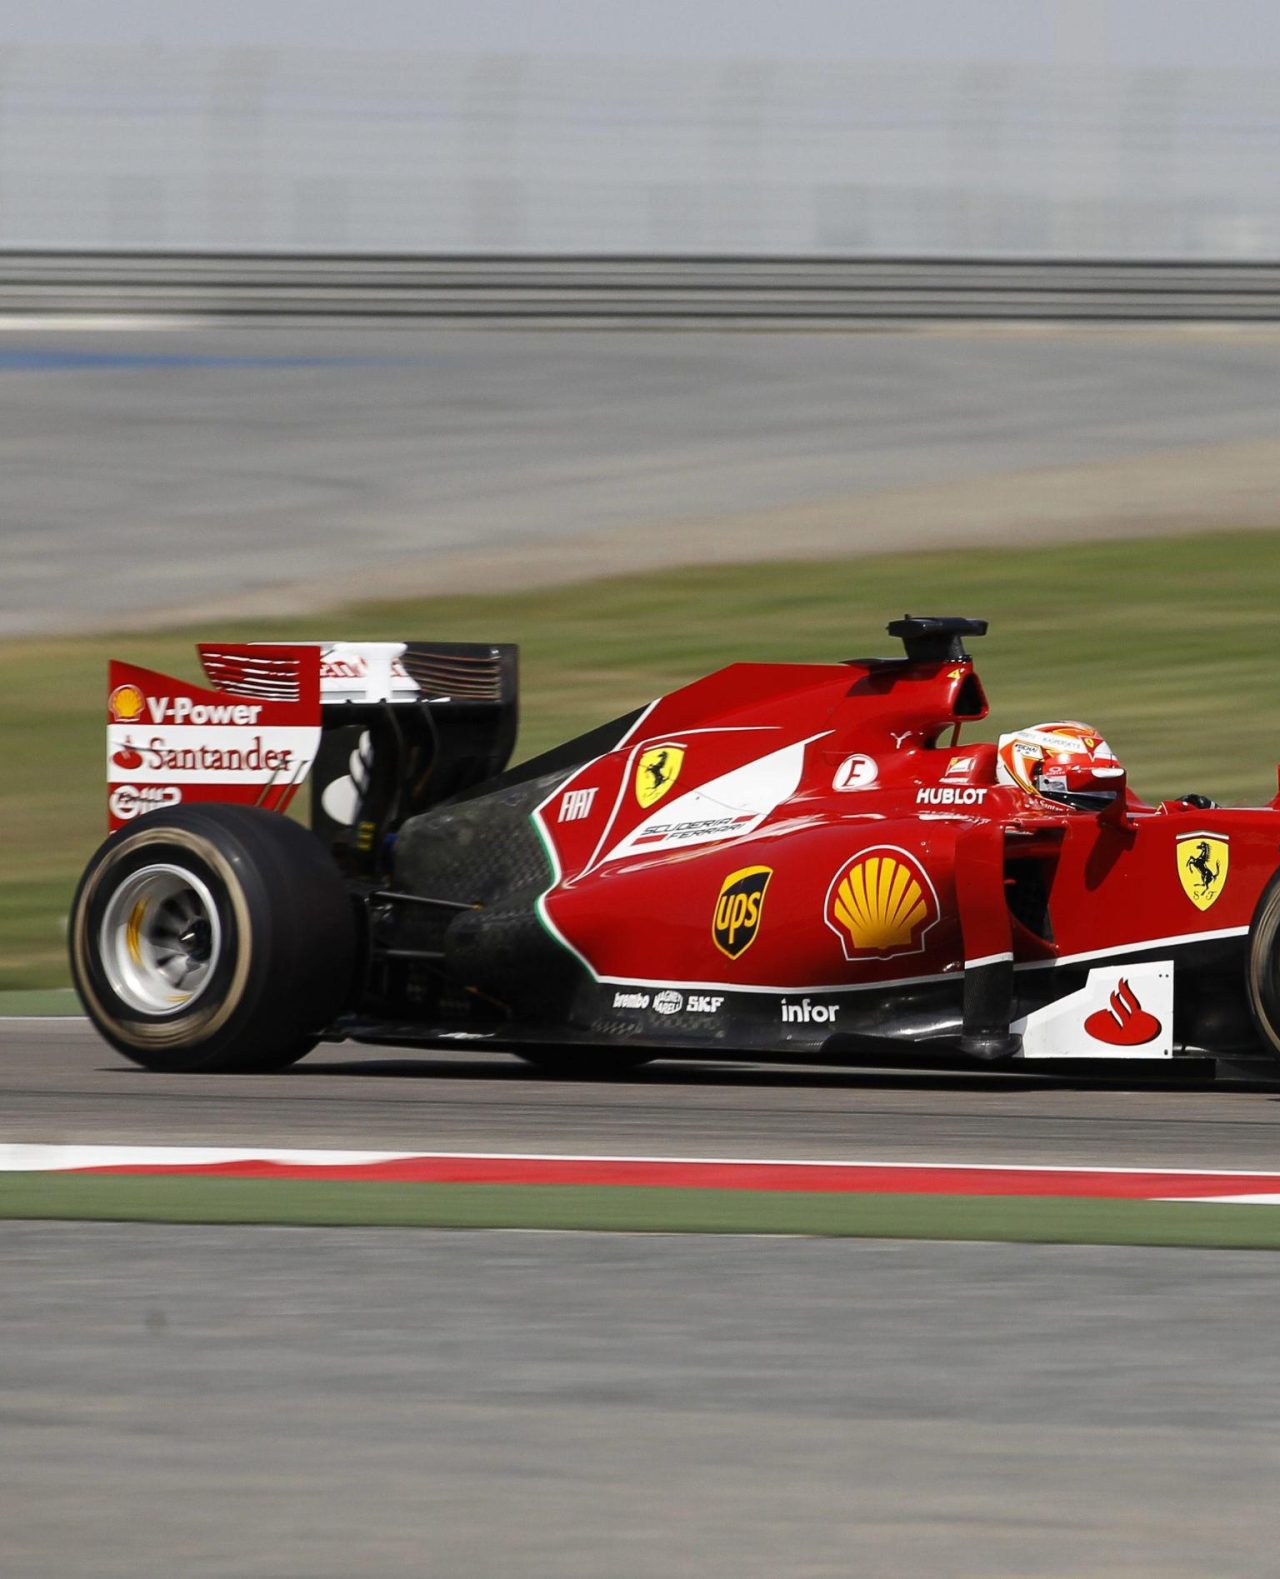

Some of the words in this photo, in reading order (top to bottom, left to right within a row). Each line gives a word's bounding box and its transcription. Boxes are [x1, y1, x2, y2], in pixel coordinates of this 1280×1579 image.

[146, 697, 262, 724] V-Power
[149, 736, 292, 771] Santander
[557, 788, 599, 823] FIAT
[915, 788, 988, 805] HUBLOT
[641, 817, 733, 836] SCUDERIA
[666, 824, 746, 841] FERRARI
[686, 995, 724, 1012] SKF
[781, 998, 839, 1022] infor
